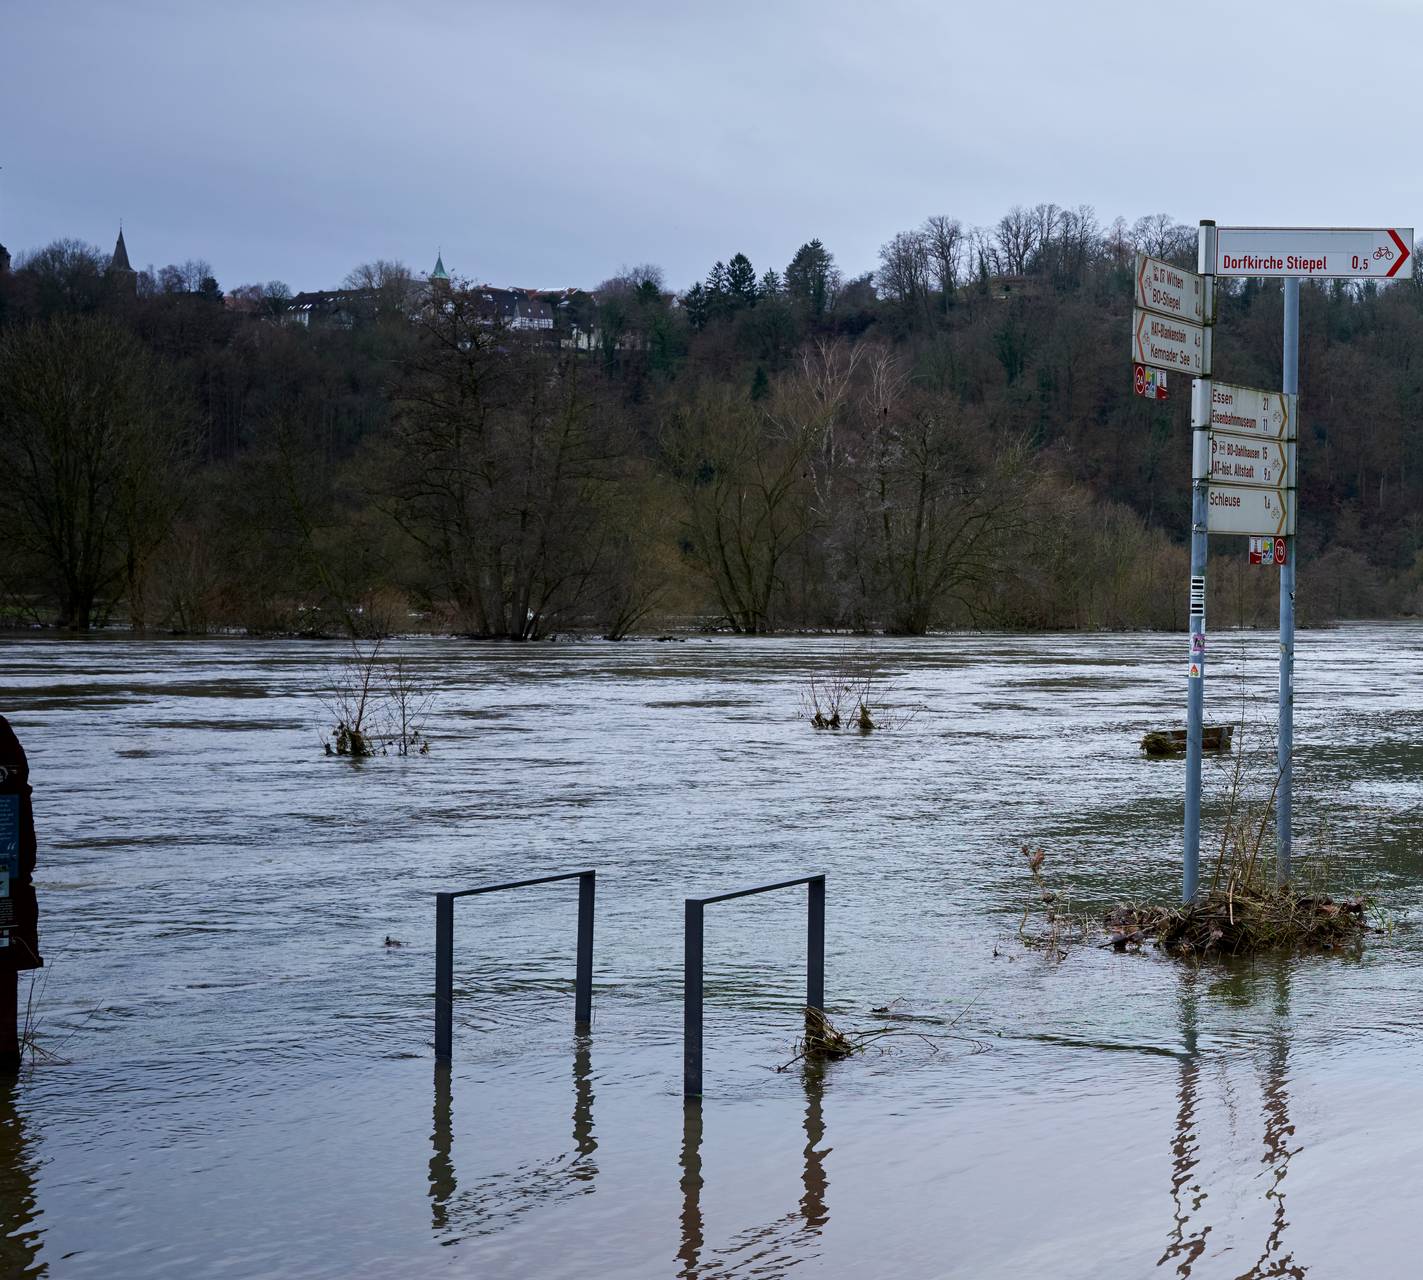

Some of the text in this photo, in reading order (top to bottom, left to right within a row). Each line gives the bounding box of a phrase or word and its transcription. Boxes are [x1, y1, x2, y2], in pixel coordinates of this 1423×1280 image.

[1223, 255, 1369, 273] Dorfkirche Stiepel 0,5
[1166, 270, 1184, 289] Witten
[1152, 288, 1181, 311] BO-Stiepel
[1151, 343, 1178, 363] Kemnader
[1180, 350, 1191, 366] See
[1212, 388, 1269, 411] Essen 21
[1212, 409, 1268, 432] Eisenbahnmuseum 11
[1226, 443, 1260, 459] BO-Dahlhausen
[1262, 446, 1268, 460] 15
[1234, 463, 1255, 478] Altstadt
[1209, 491, 1241, 507] Schleuse
